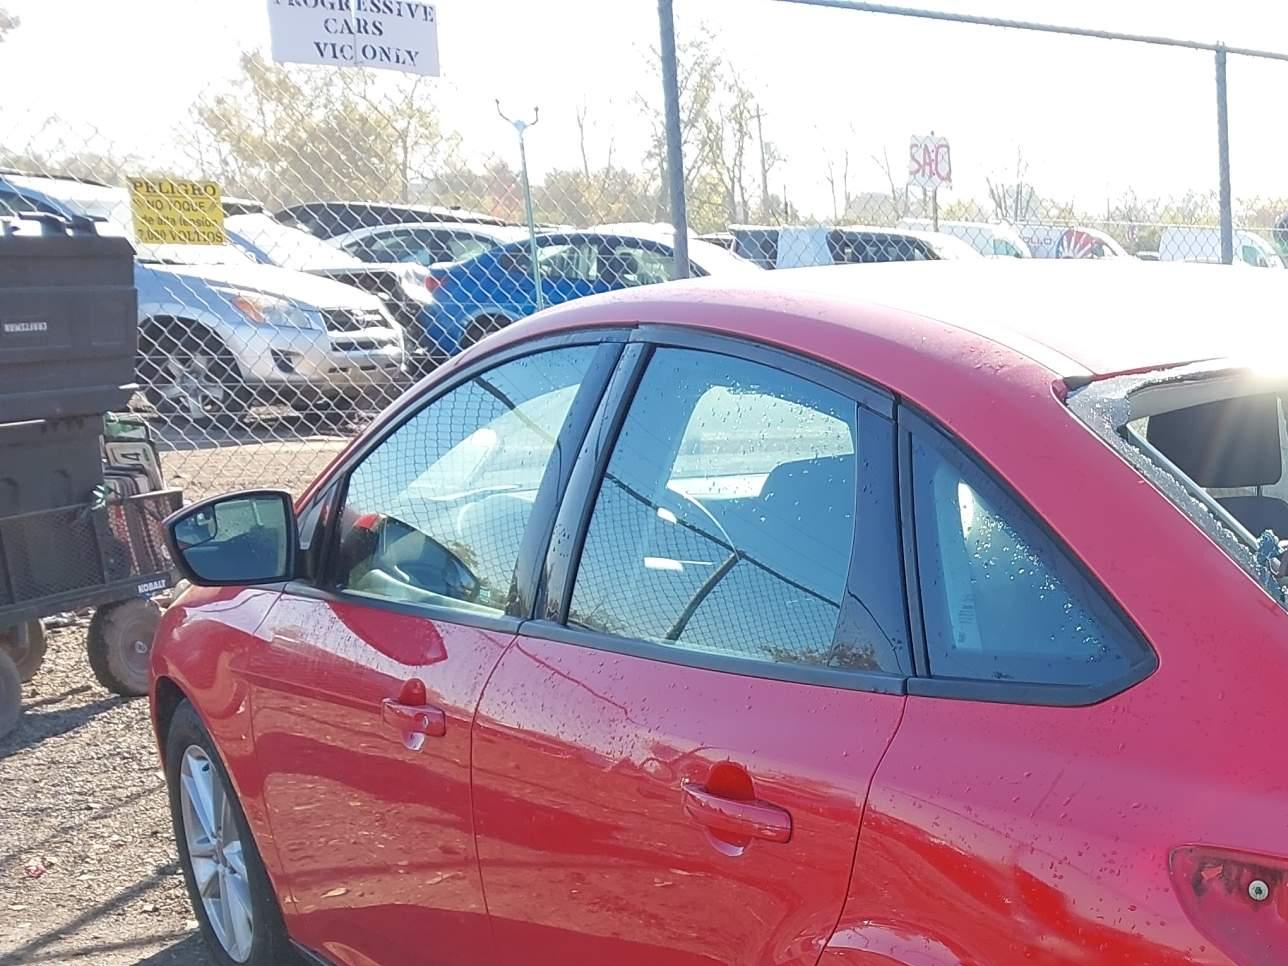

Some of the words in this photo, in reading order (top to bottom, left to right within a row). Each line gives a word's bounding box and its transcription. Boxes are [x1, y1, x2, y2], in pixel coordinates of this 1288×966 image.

[323, 17, 384, 36] CARS
[313, 42, 354, 61] VIC
[361, 44, 420, 66] ONLY
[133, 181, 216, 196] PELIGRO
[146, 199, 163, 210] NO
[169, 230, 224, 243] VOLTIOS
[138, 579, 166, 593] KOBALT
